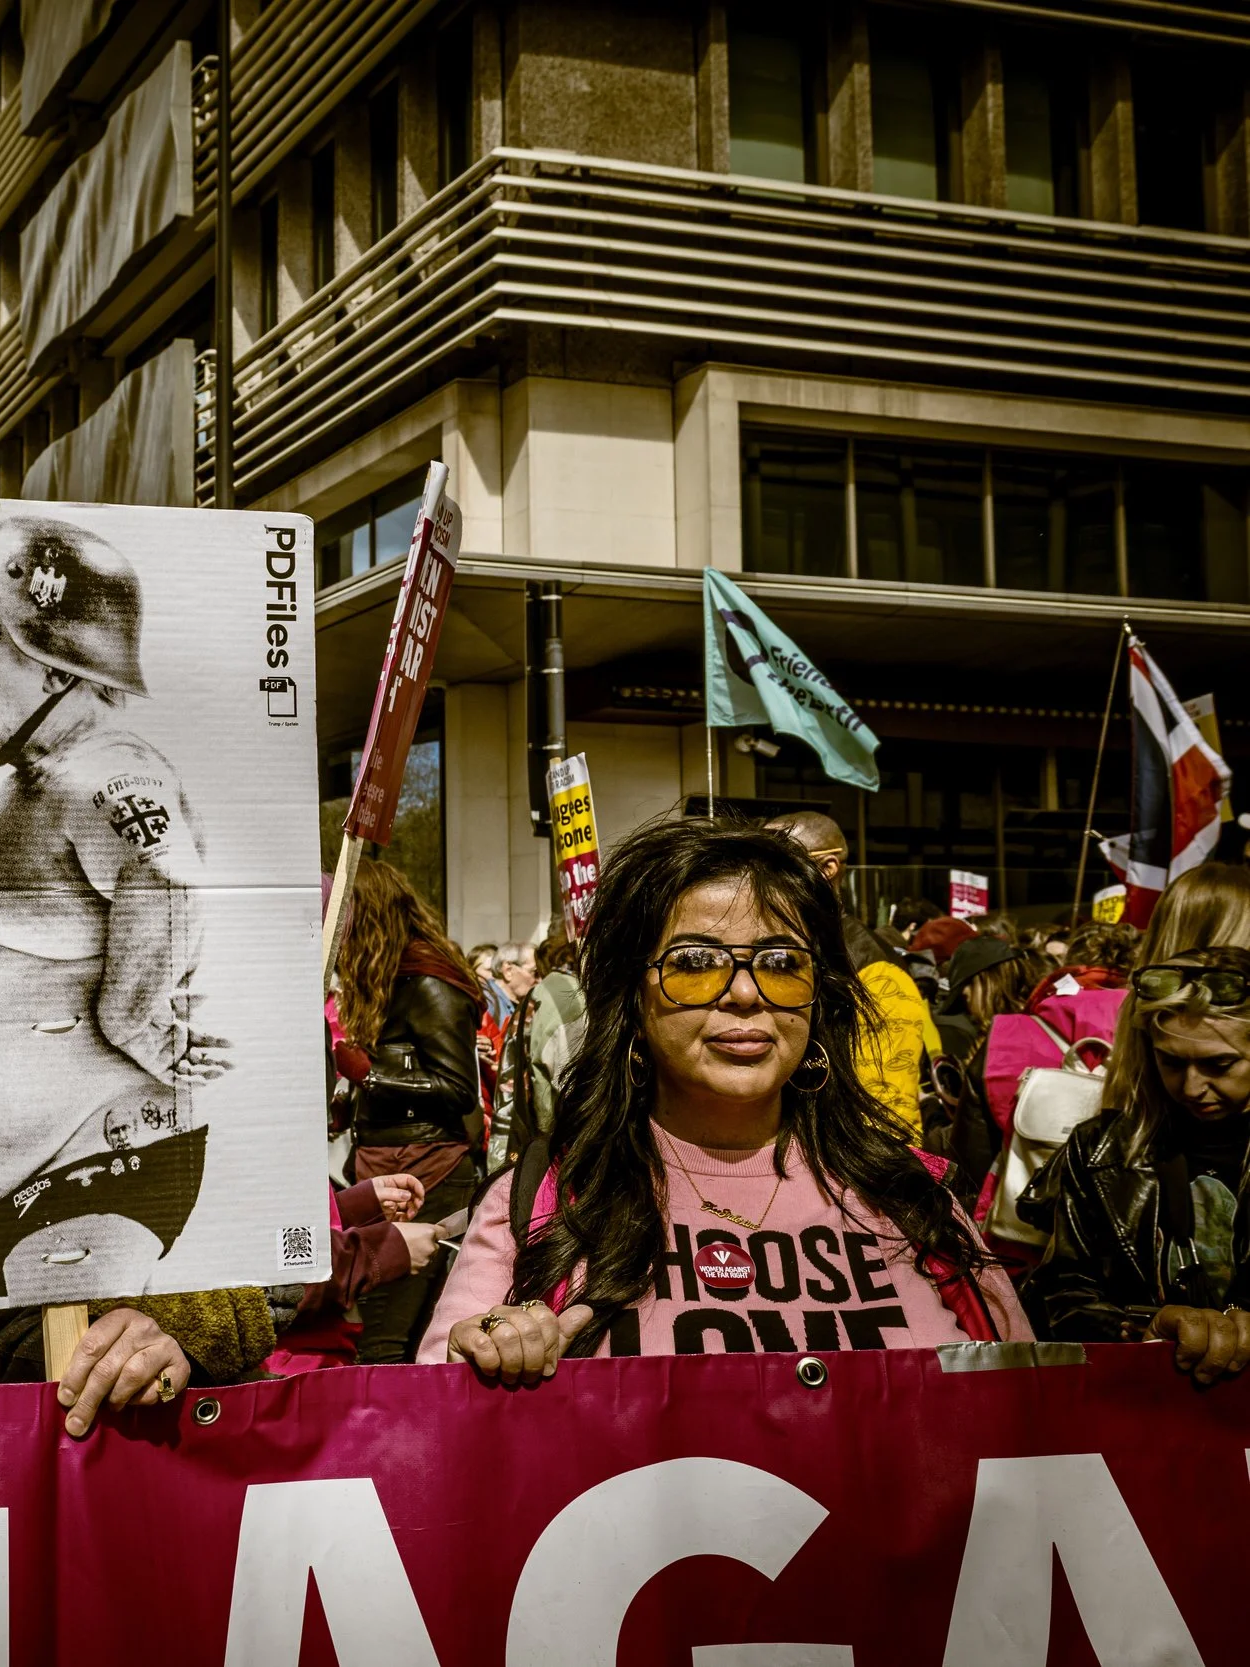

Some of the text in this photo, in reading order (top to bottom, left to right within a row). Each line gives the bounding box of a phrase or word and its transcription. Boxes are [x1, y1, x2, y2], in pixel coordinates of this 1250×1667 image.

[264, 525, 297, 669] PDFiles
[264, 681, 282, 690] PDF
[653, 1223, 899, 1304] HOOSE
[699, 1265, 724, 1273] WOMEN
